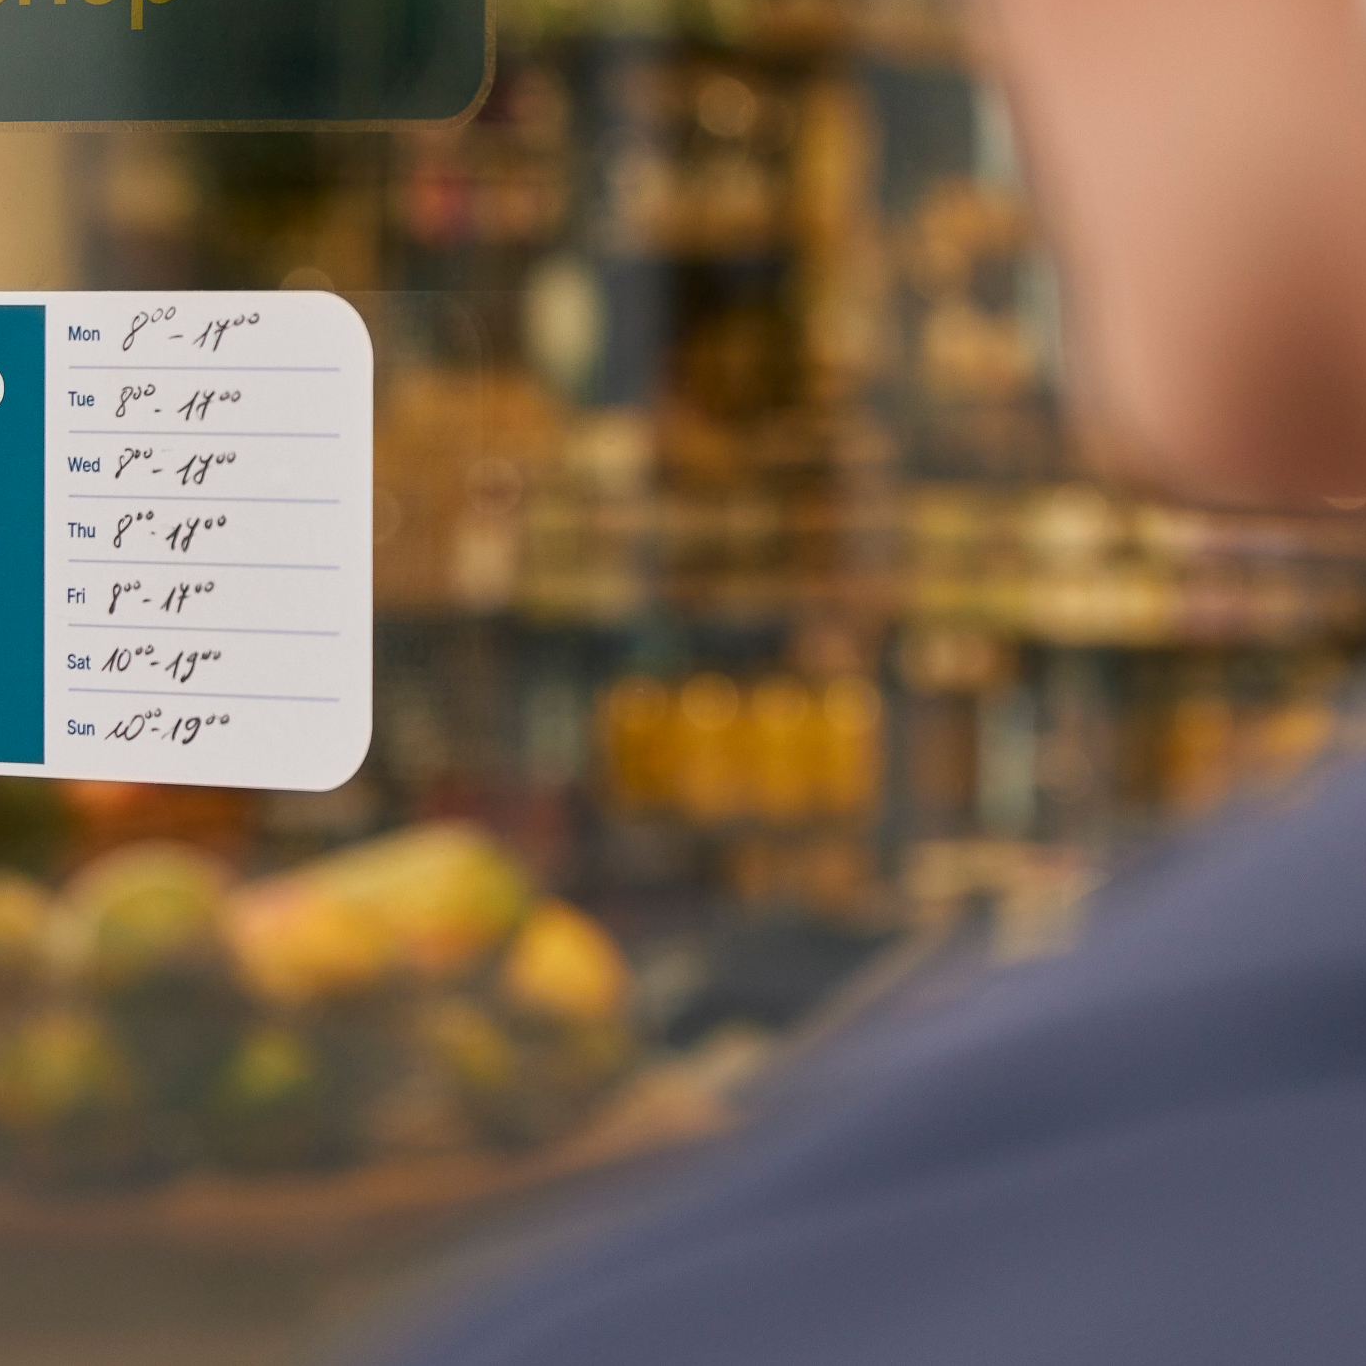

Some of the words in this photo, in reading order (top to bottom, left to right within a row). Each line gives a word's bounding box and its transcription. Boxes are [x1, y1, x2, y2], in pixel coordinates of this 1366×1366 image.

[68, 325, 101, 342] Mon
[67, 390, 95, 407] Tue
[67, 456, 101, 473] Wed
[67, 522, 96, 539] Thu
[67, 587, 86, 604] Fri
[67, 653, 91, 670] Sat
[67, 719, 95, 736] Sun
